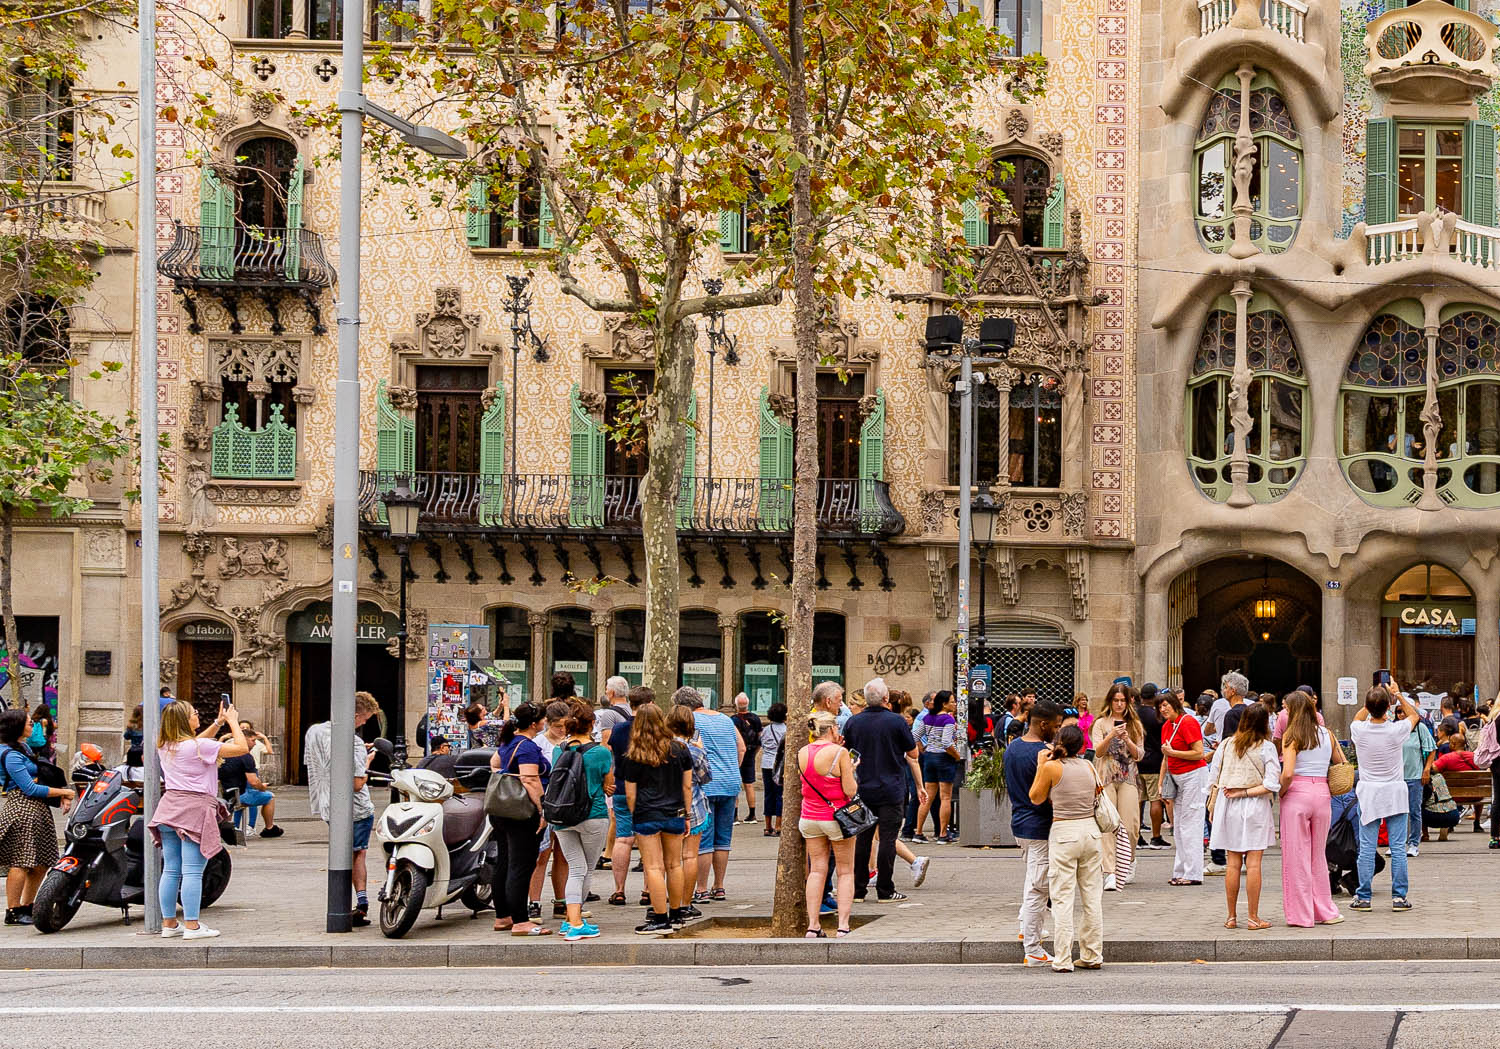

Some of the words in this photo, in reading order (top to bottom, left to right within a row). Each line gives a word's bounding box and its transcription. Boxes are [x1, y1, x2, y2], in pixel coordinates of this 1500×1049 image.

[315, 613, 333, 625] CA
[355, 613, 384, 625] USEU
[1401, 607, 1458, 626] CASA
[310, 625, 386, 639] AMLLER
